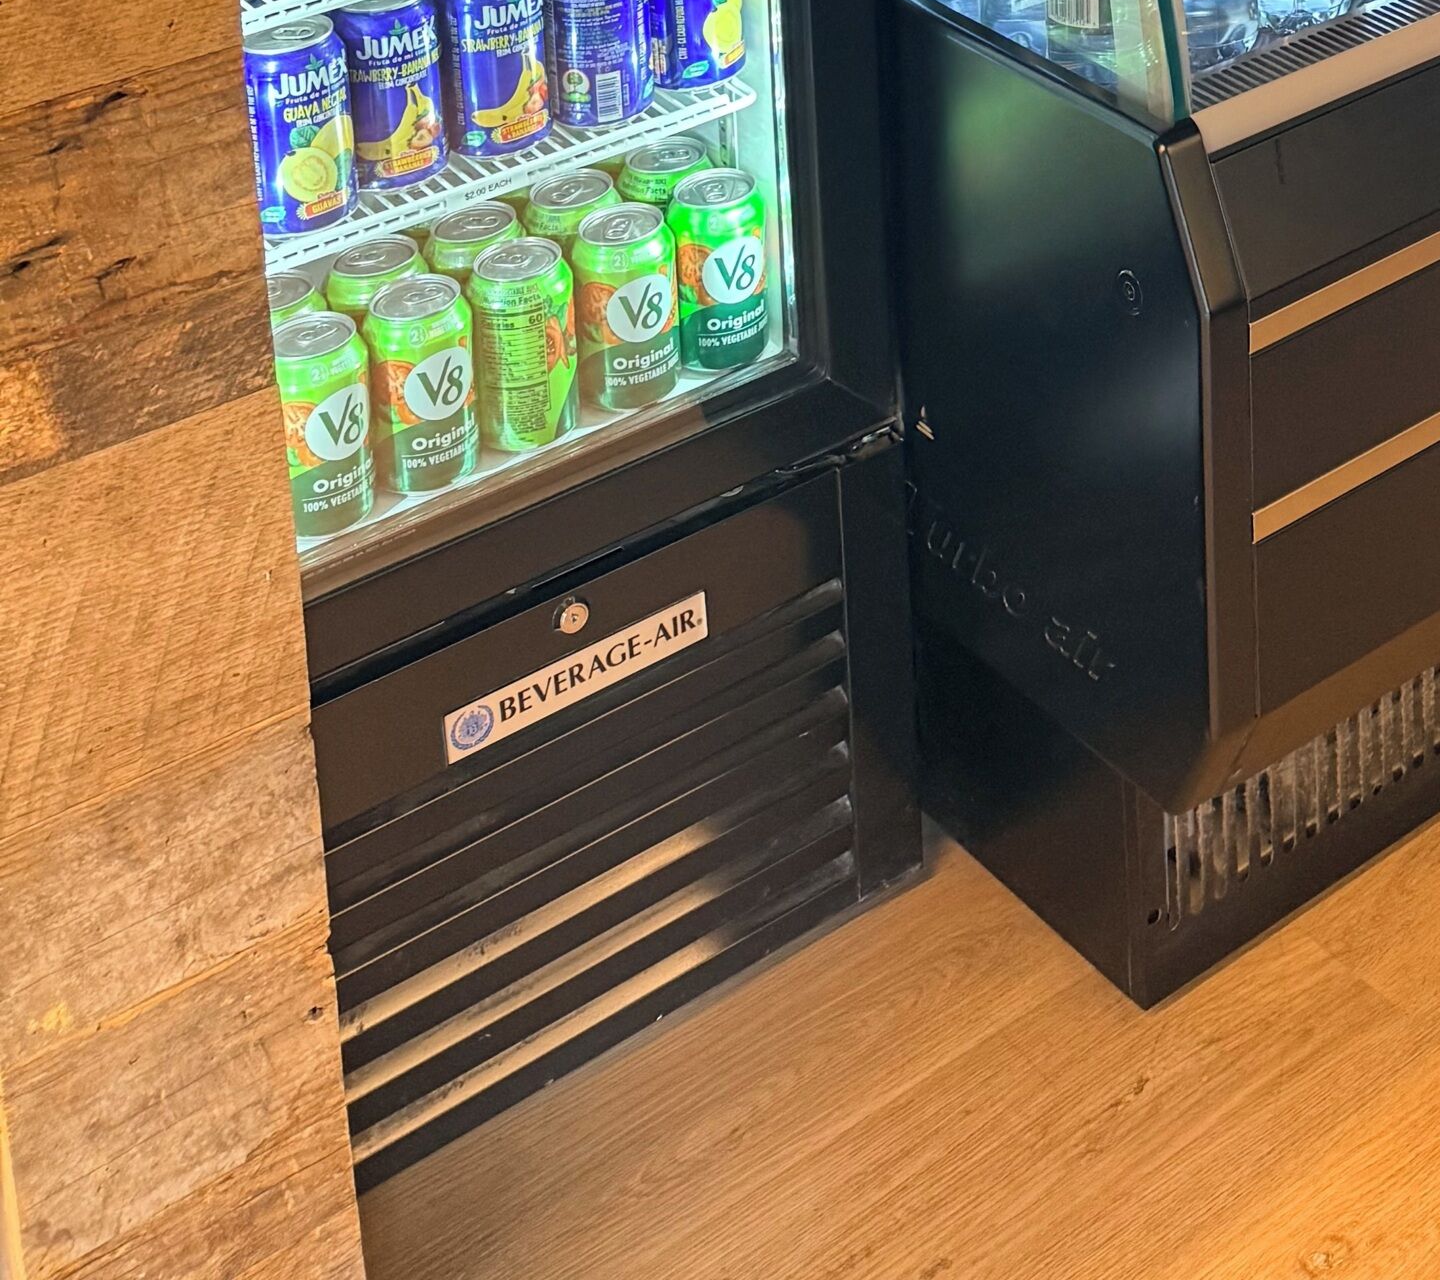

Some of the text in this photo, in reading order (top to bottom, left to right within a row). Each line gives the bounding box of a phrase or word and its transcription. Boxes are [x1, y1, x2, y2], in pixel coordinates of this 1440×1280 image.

[283, 100, 320, 124] GUAVA
[464, 176, 514, 201] $2.00 EACH
[713, 243, 756, 292] V8
[528, 313, 543, 325] 60
[618, 281, 663, 330] V8
[706, 302, 765, 332] Original
[697, 322, 758, 349] 100% VEGETABLE
[612, 338, 675, 372] Original
[416, 355, 464, 408] V8
[605, 363, 667, 388] 100% VEGETABLE
[318, 392, 366, 447] V8
[401, 455, 428, 470] 100%
[302, 498, 329, 513] 100%
[498, 608, 697, 723] BEVERAGE-AIR
